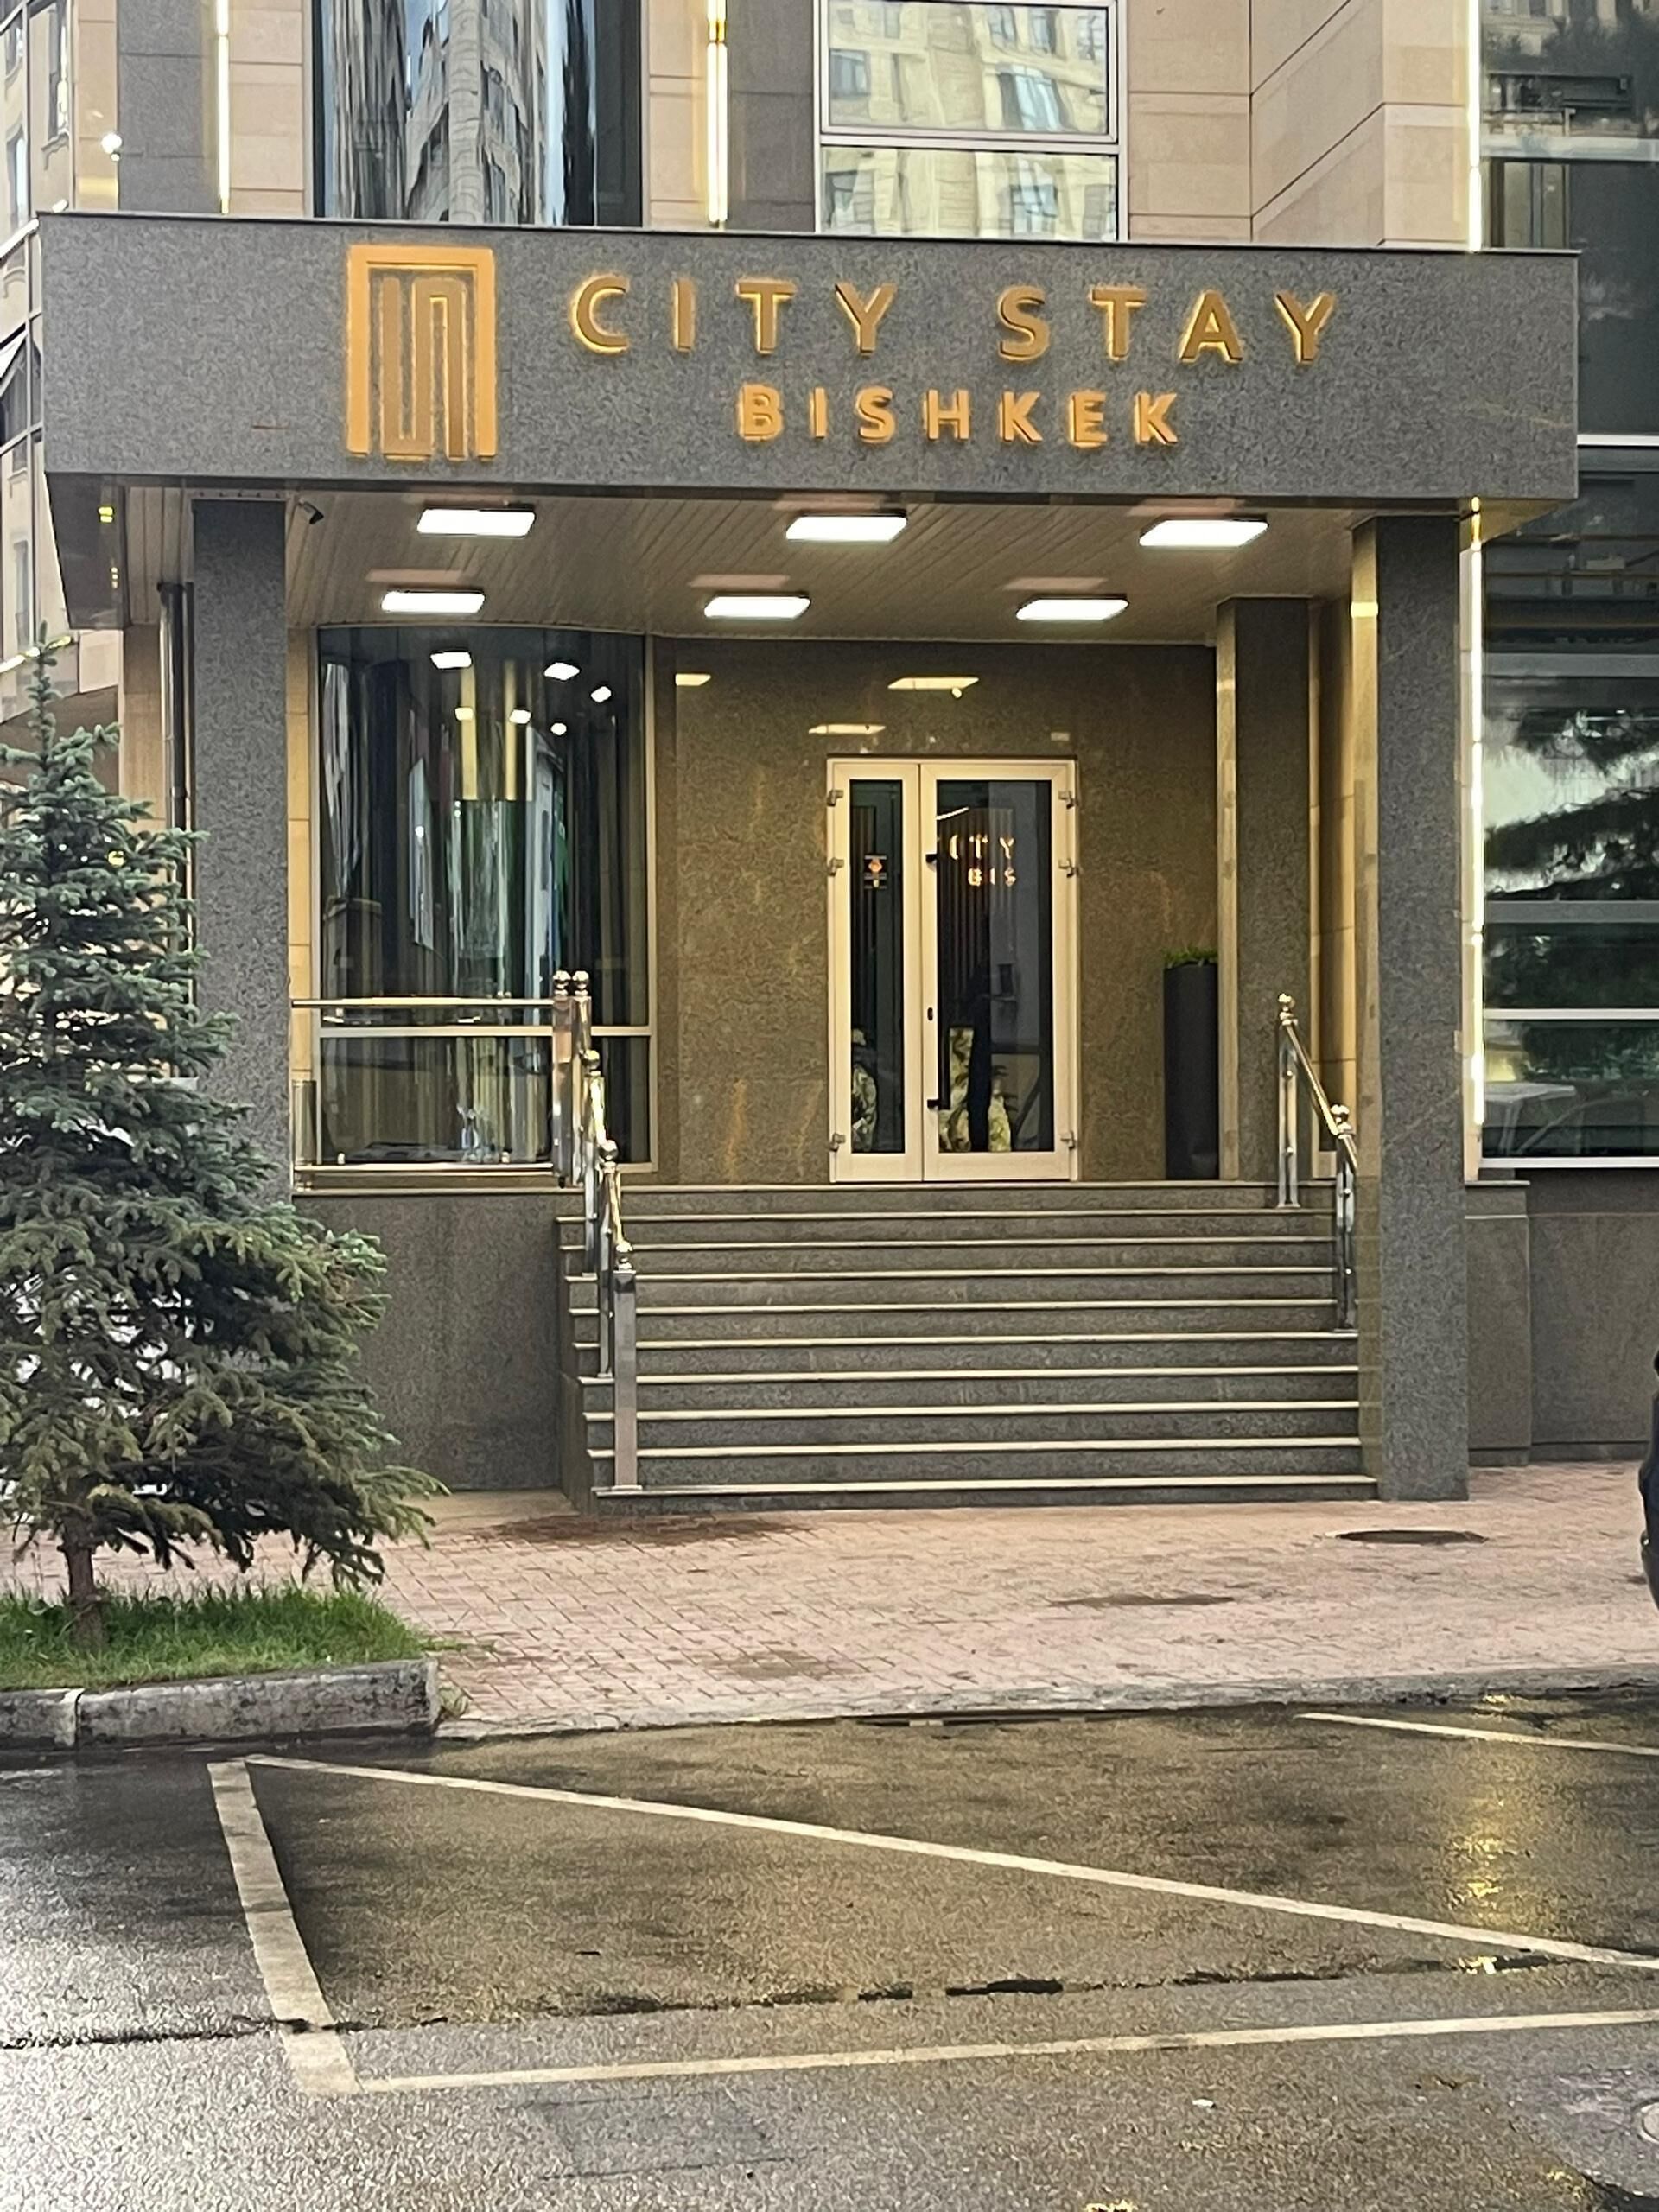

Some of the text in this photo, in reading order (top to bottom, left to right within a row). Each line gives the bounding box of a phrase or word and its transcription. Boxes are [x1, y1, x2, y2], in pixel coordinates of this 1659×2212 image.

[569, 273, 1338, 364] CITY STAY
[737, 383, 1179, 448] BISHKEK
